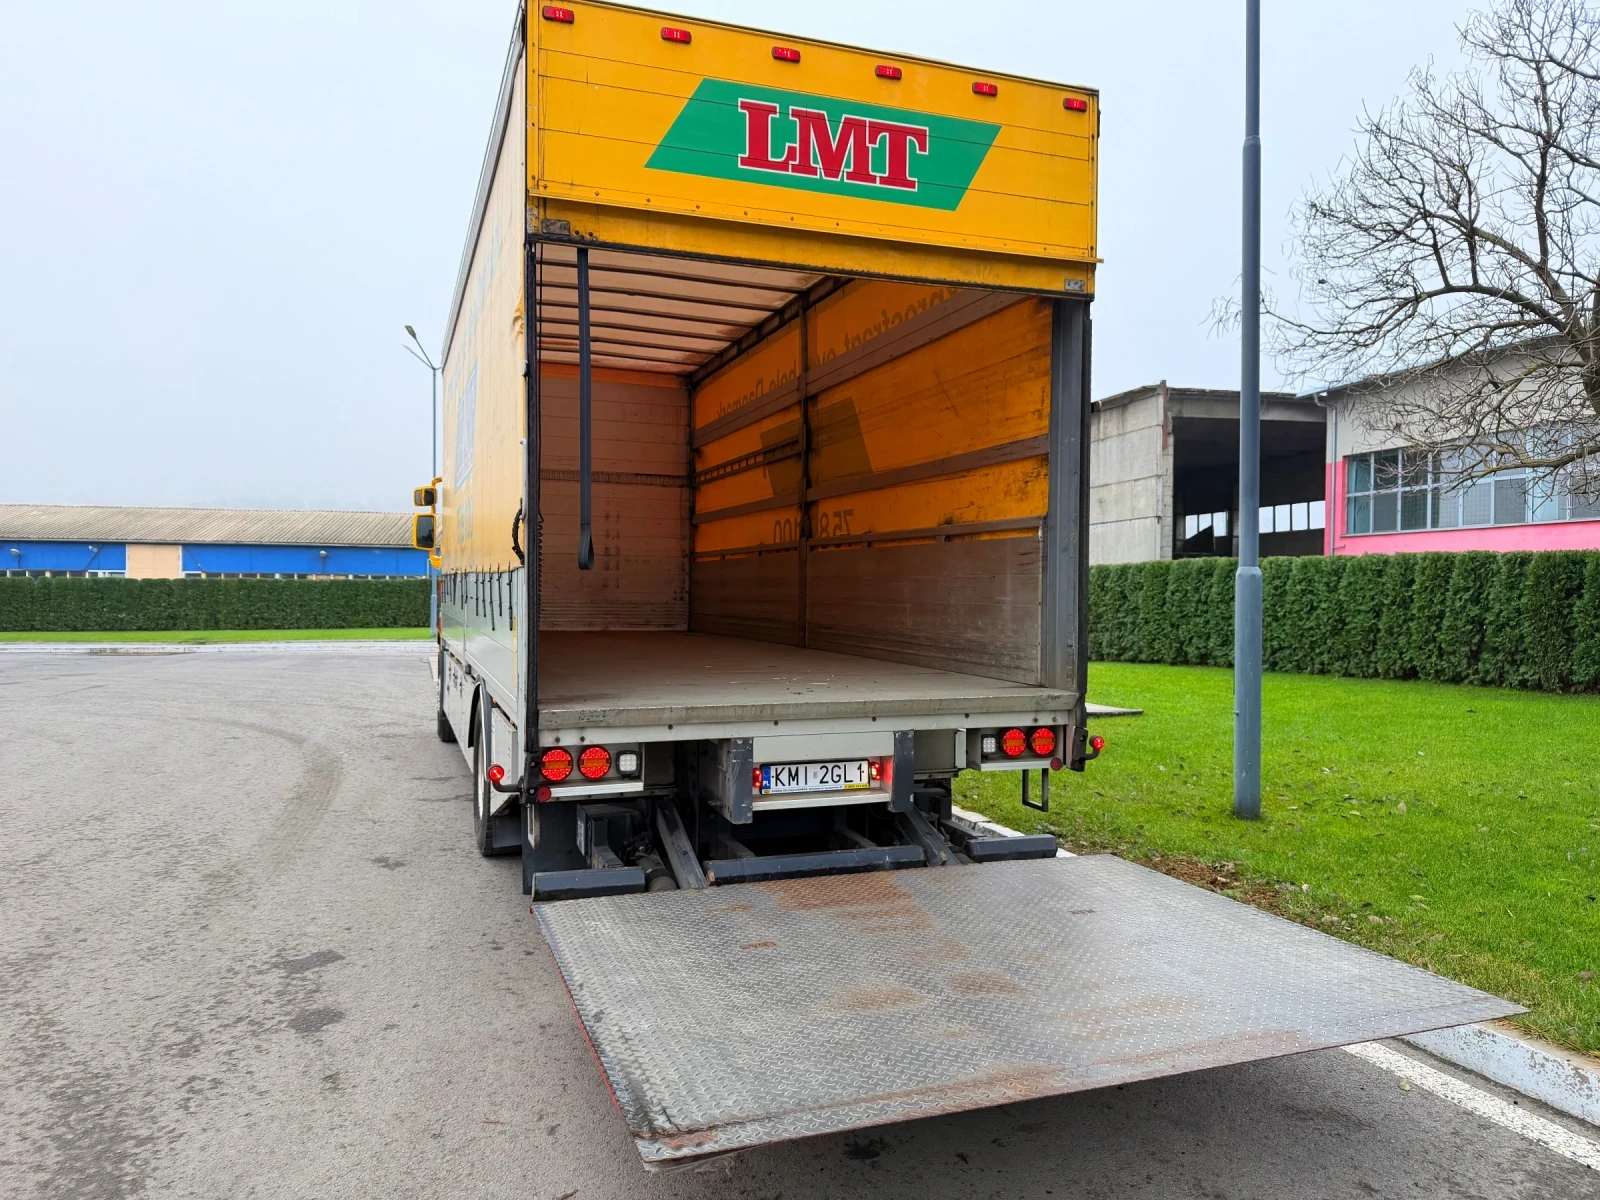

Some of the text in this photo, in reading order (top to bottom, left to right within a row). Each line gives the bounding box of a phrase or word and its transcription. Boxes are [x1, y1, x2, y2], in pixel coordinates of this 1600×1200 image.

[738, 97, 929, 192] LMT
[775, 763, 863, 787] KMI 2GL1
